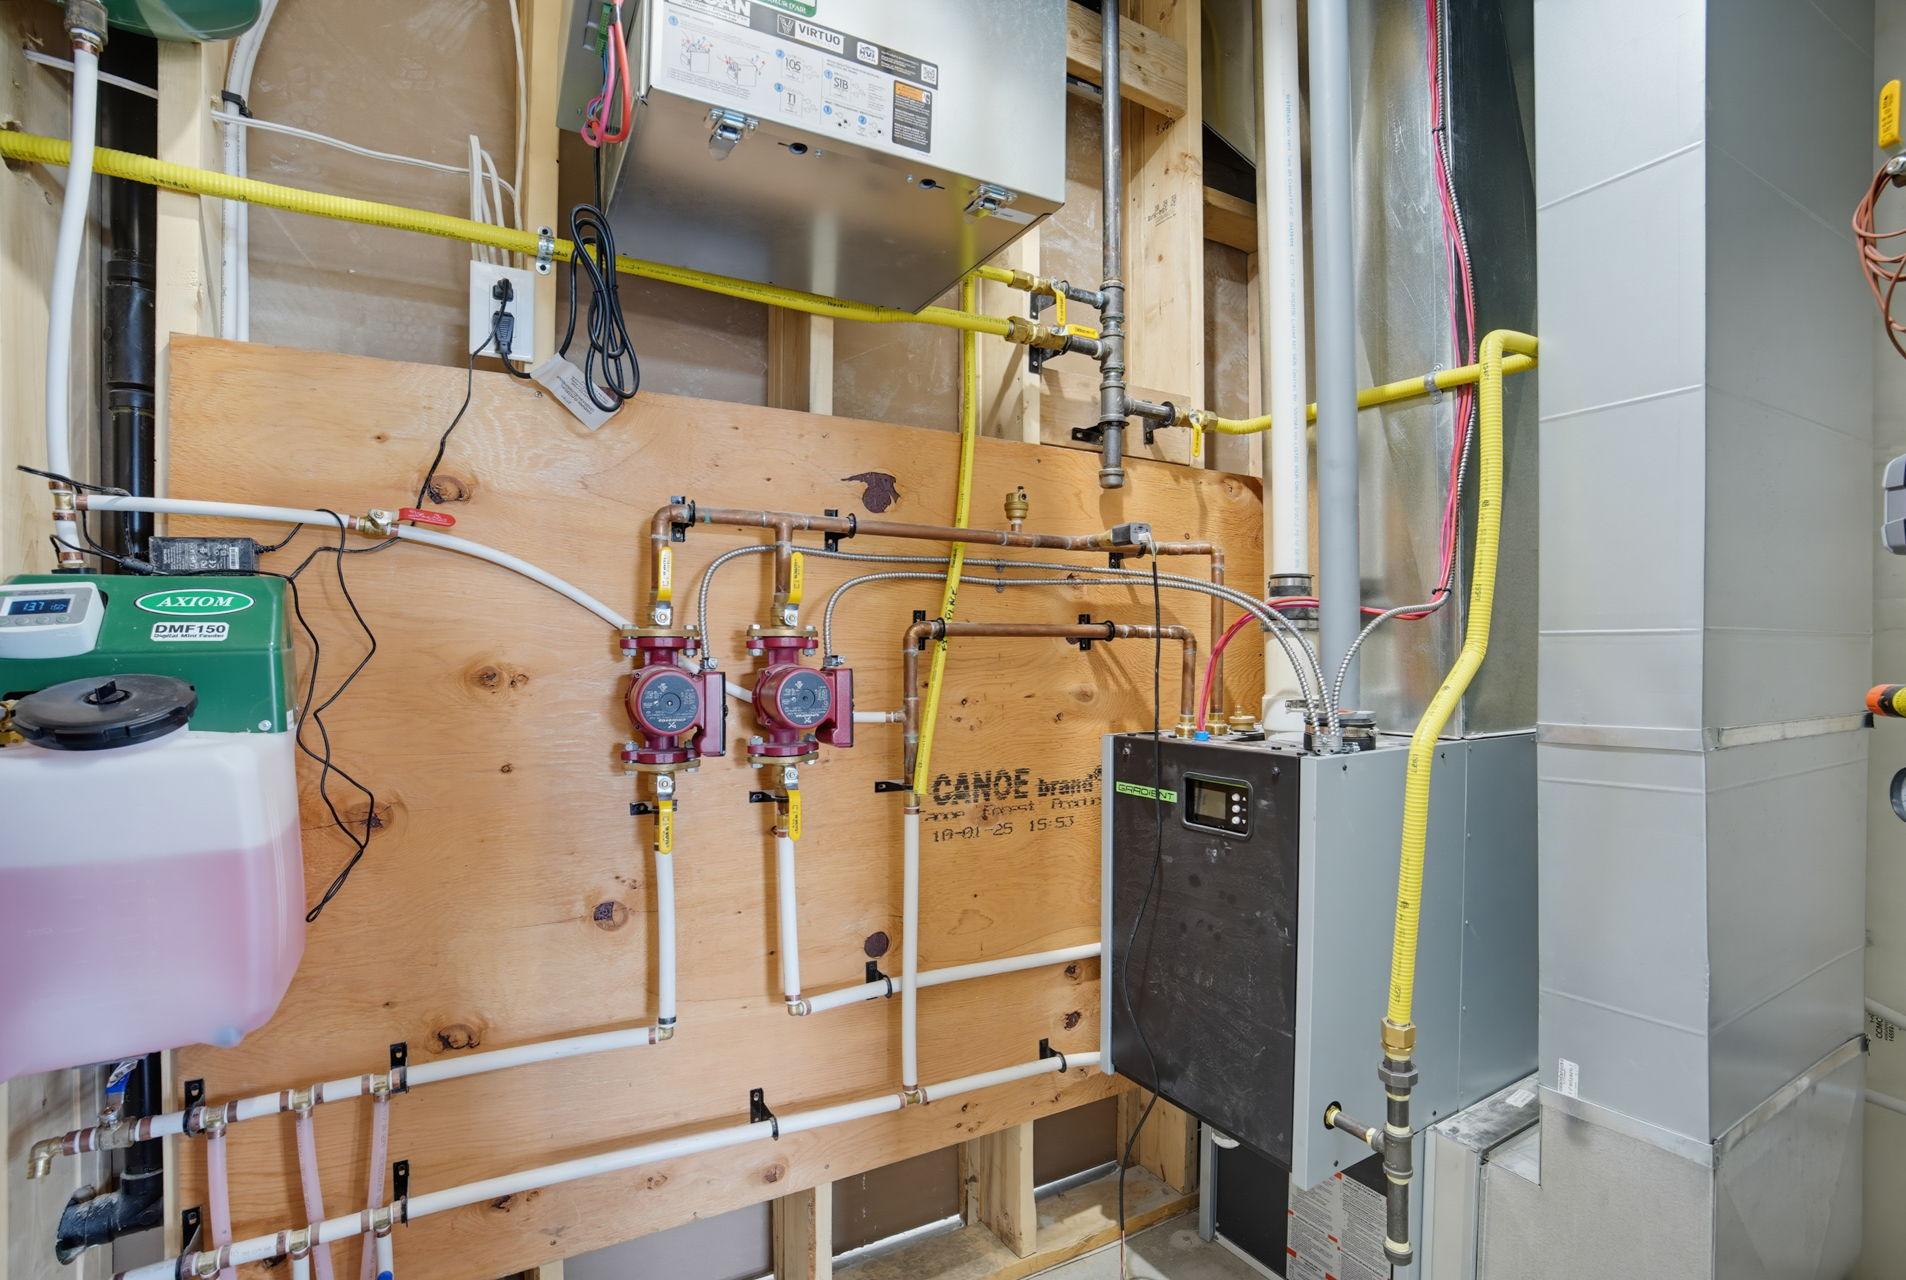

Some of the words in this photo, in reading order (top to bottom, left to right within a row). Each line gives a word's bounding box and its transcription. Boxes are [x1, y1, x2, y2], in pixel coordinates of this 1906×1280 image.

[798, 23, 841, 46] VIRTUO
[156, 596, 234, 607] AXIOM
[154, 624, 226, 633] DMF150
[932, 768, 1030, 806] CANOE
